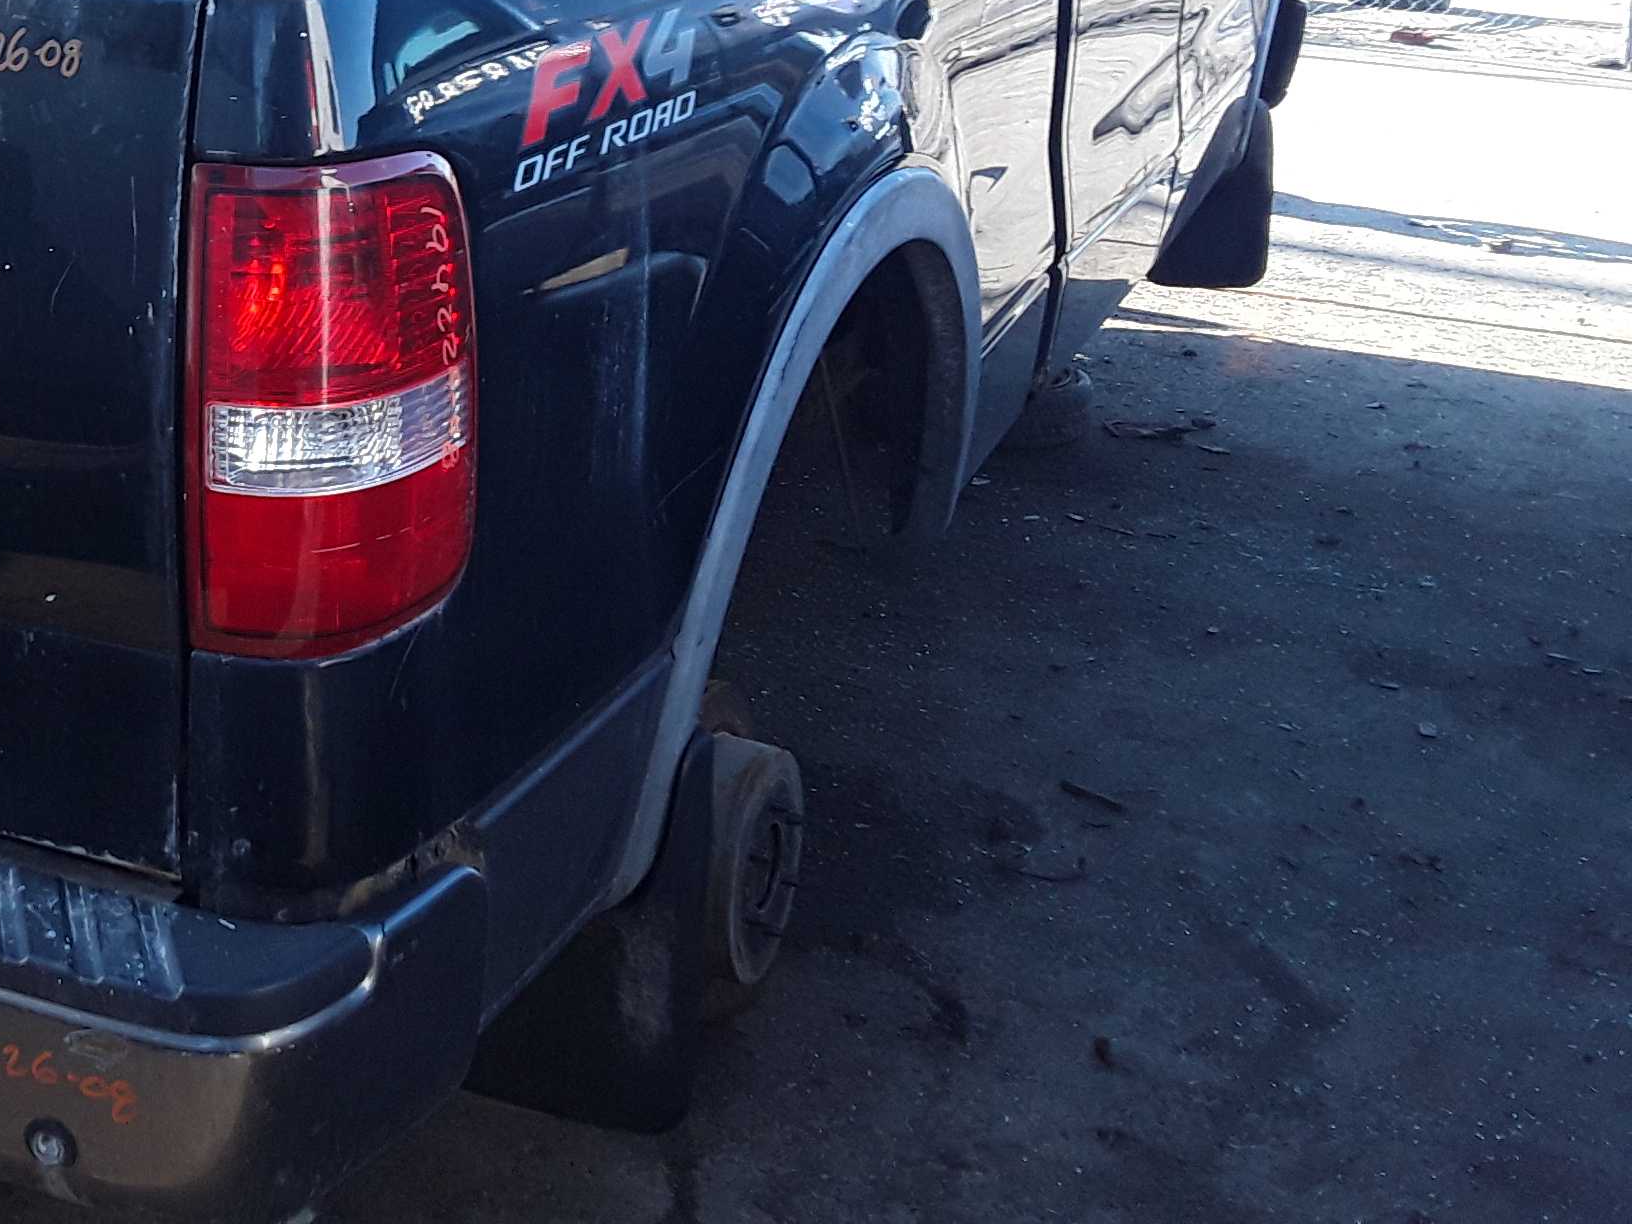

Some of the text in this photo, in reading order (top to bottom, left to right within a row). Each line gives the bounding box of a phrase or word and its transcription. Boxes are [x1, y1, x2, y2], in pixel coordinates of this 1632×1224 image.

[521, 8, 697, 148] FX4
[513, 89, 697, 203] OFF ROAD
